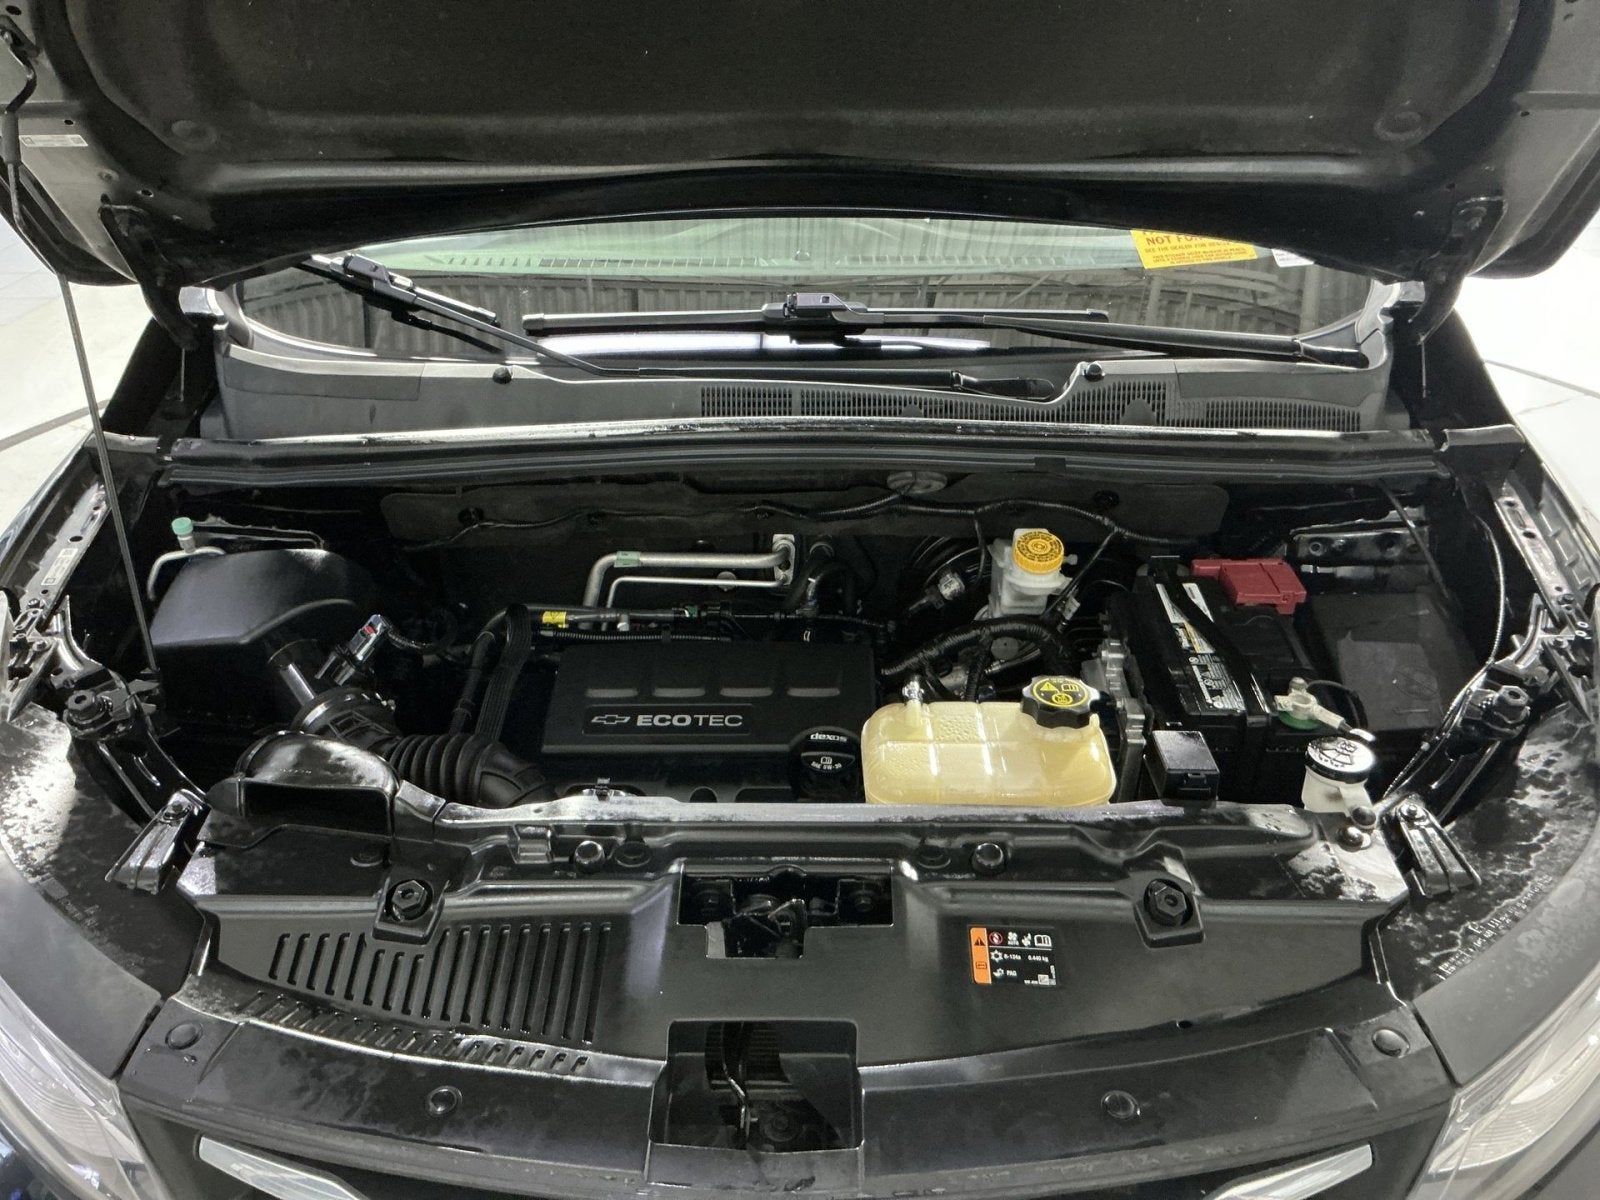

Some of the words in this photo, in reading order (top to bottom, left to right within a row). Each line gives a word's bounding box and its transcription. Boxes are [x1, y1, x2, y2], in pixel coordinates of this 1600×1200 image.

[1146, 235, 1172, 246] NOT
[636, 714, 743, 727] ECOTEC
[810, 732, 847, 742] dexos
